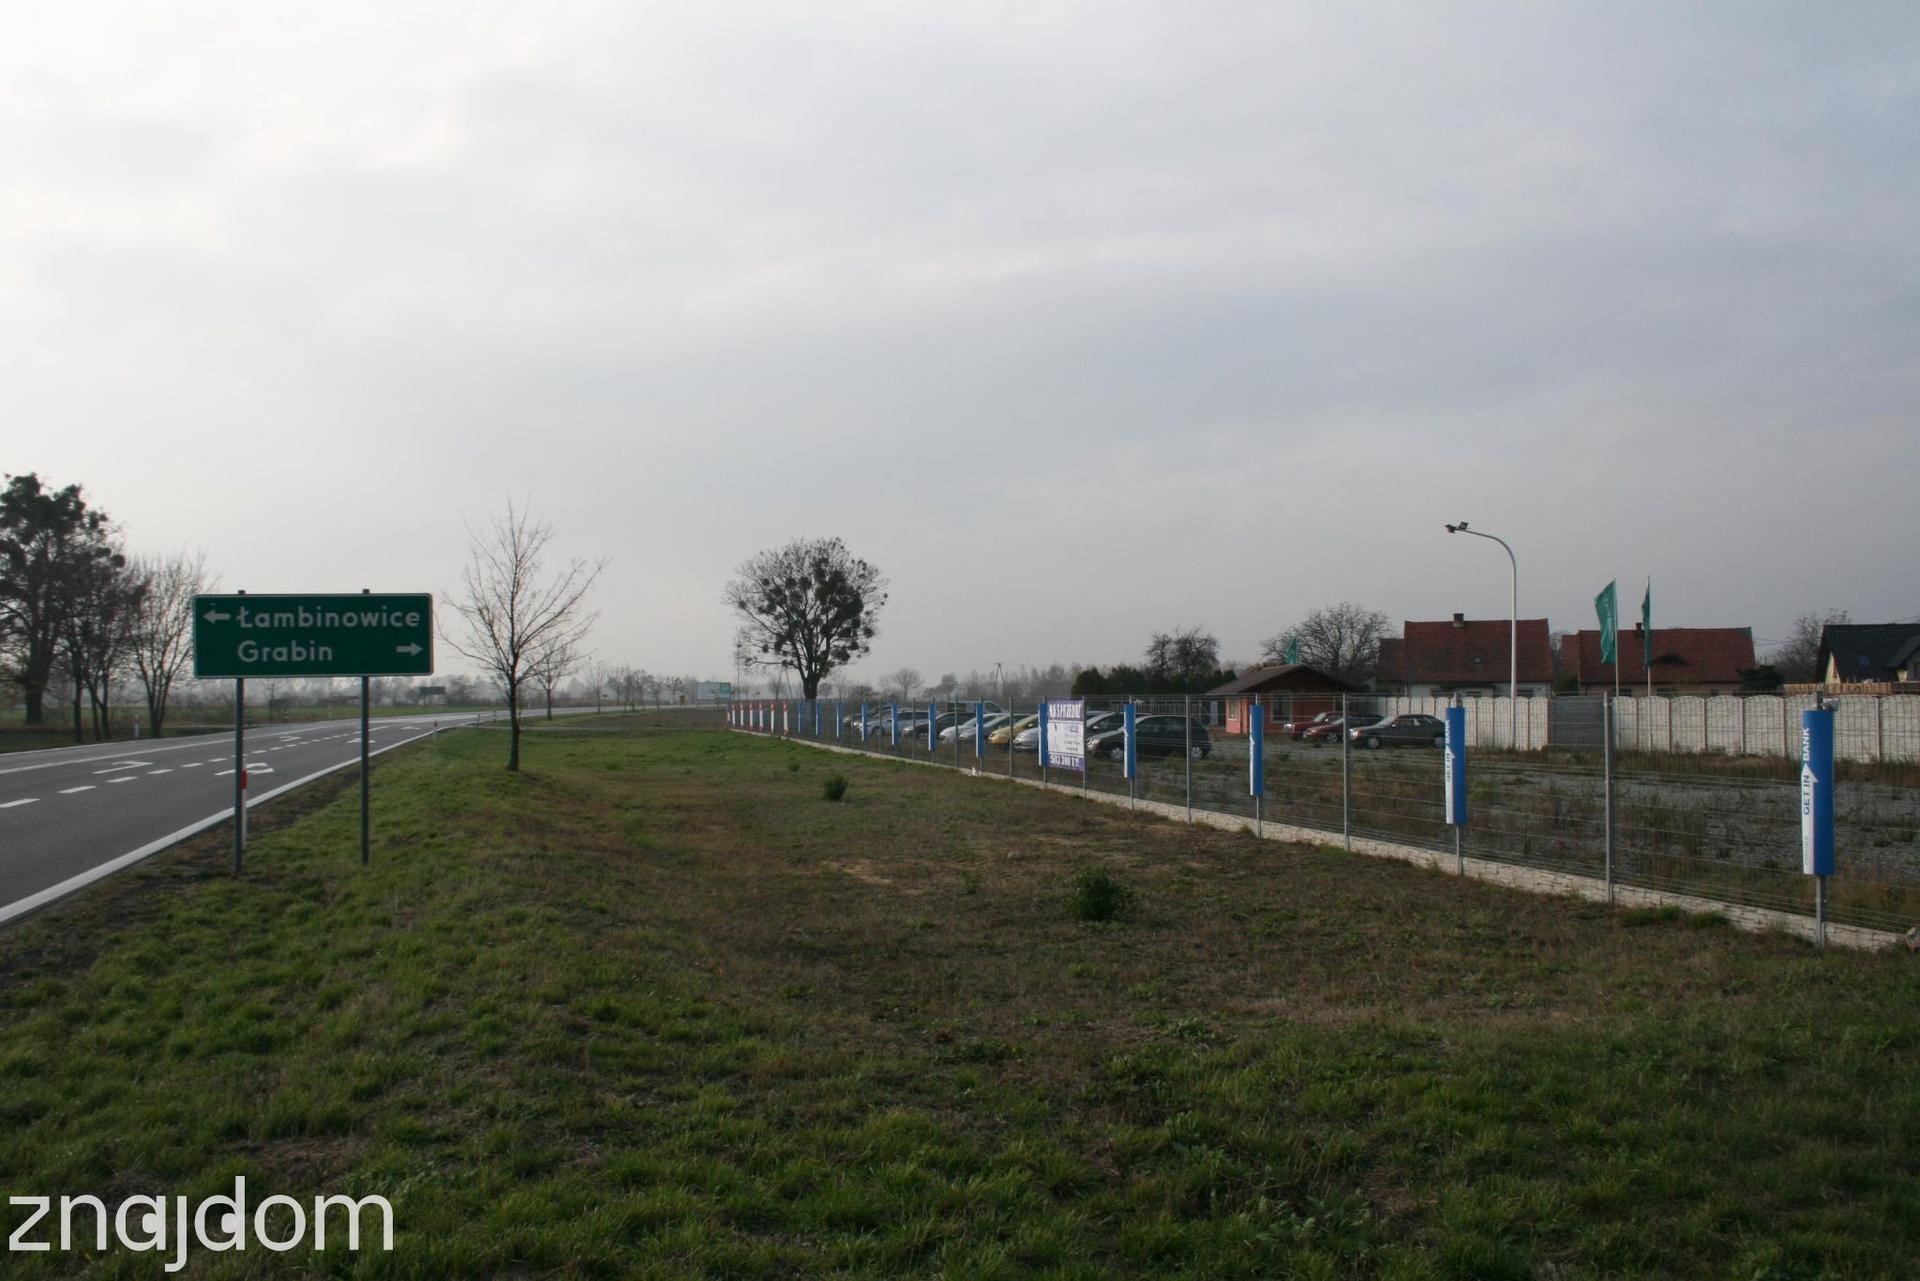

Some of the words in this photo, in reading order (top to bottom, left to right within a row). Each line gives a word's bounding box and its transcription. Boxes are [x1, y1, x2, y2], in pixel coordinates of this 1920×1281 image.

[236, 605, 420, 628] Łambinowice
[237, 640, 333, 662] Grabin
[1802, 727, 1810, 762] BANK
